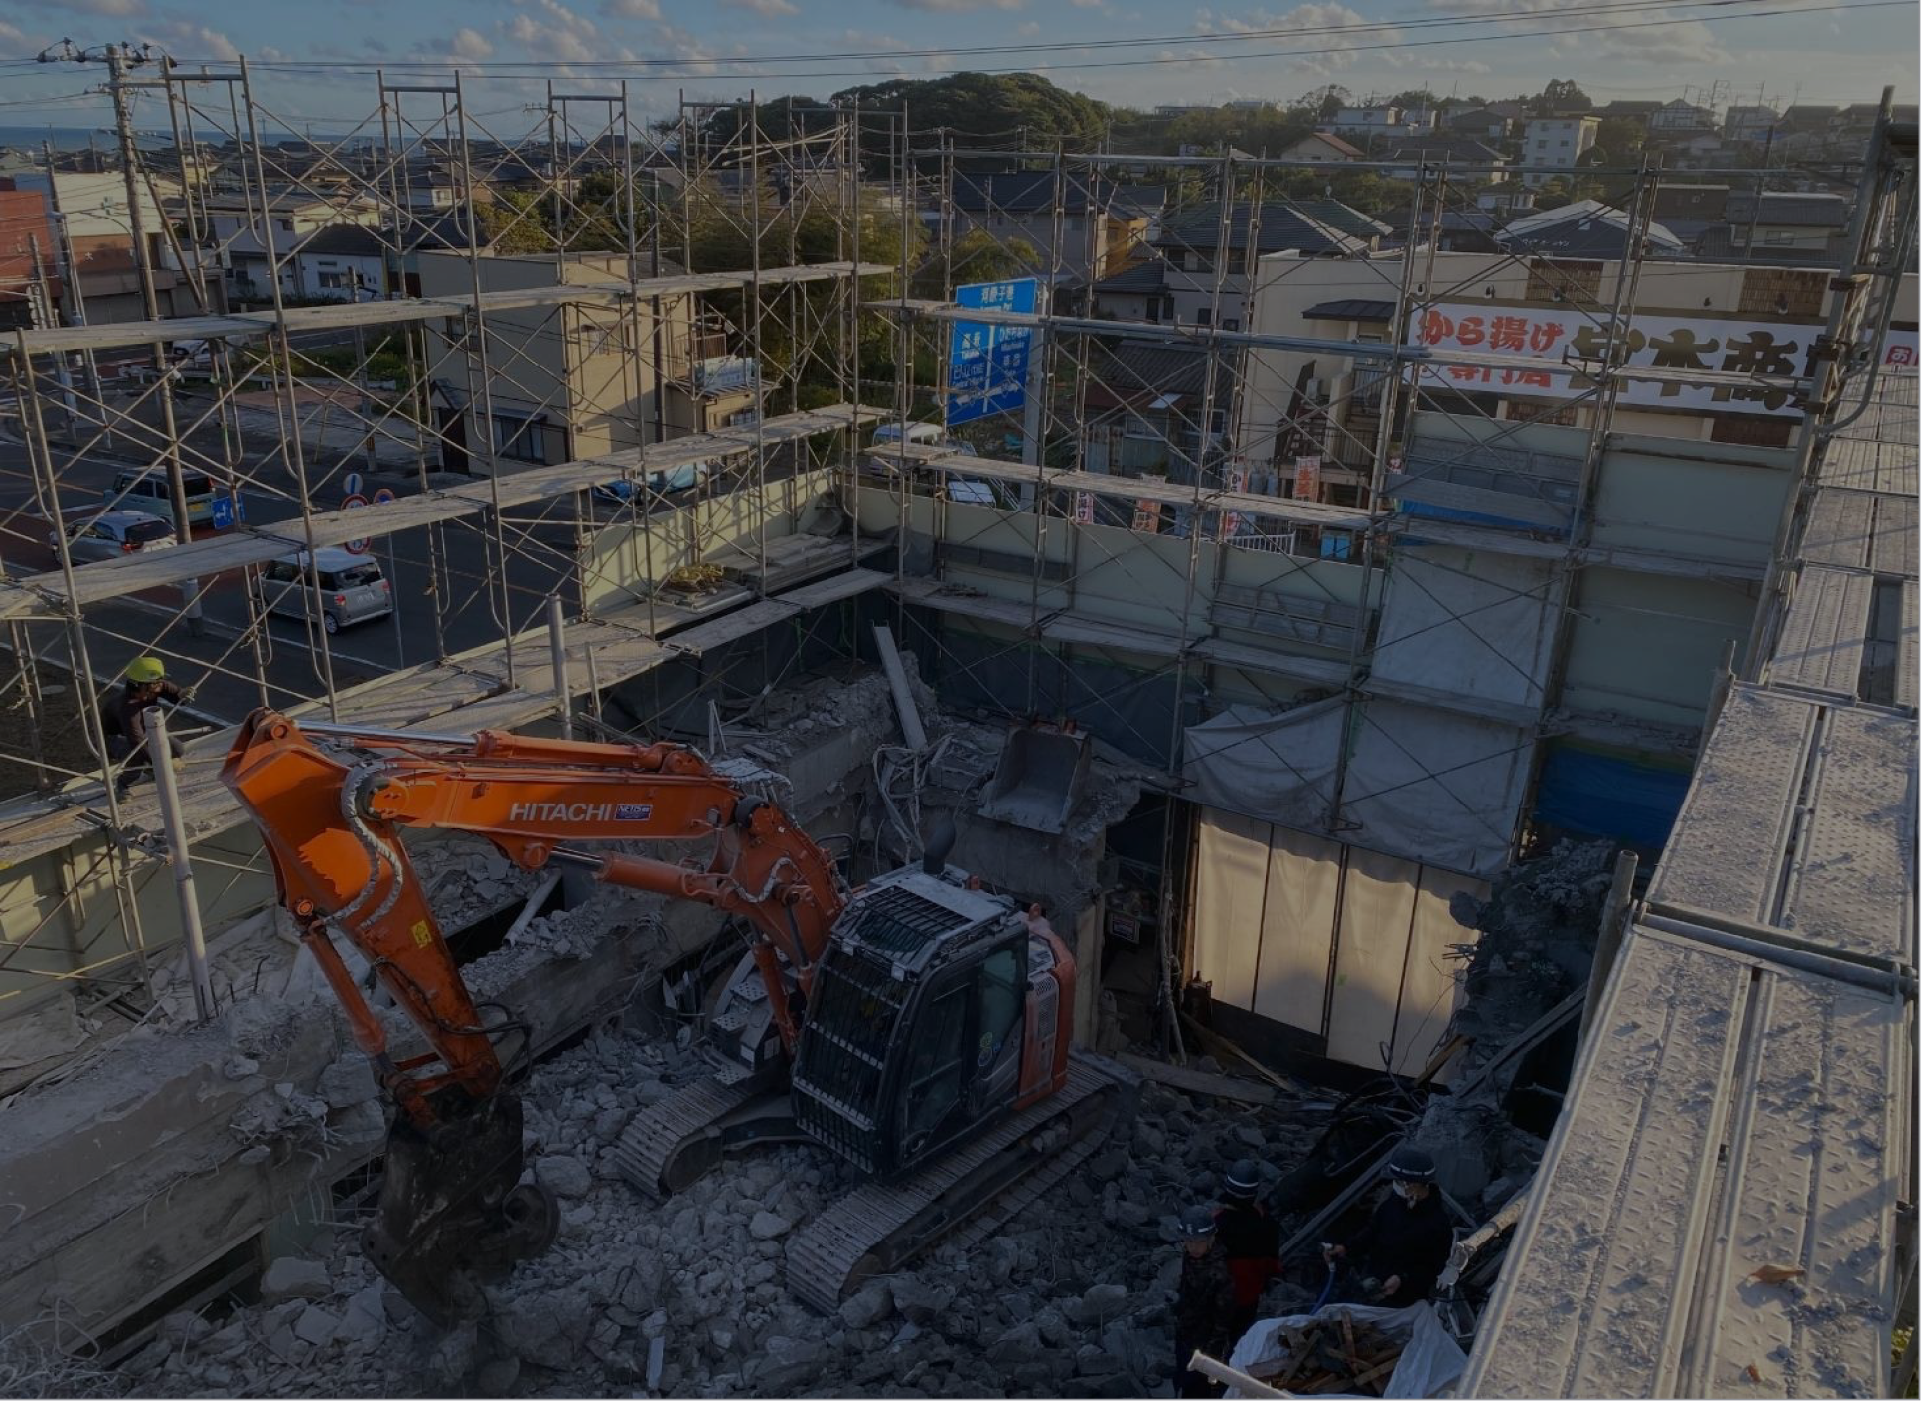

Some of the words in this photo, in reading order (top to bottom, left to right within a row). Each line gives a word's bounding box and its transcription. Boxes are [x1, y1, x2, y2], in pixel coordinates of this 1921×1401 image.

[1416, 310, 1564, 352] から揚げ
[1420, 364, 1552, 388] 専門店
[510, 803, 612, 821] HITACHI
